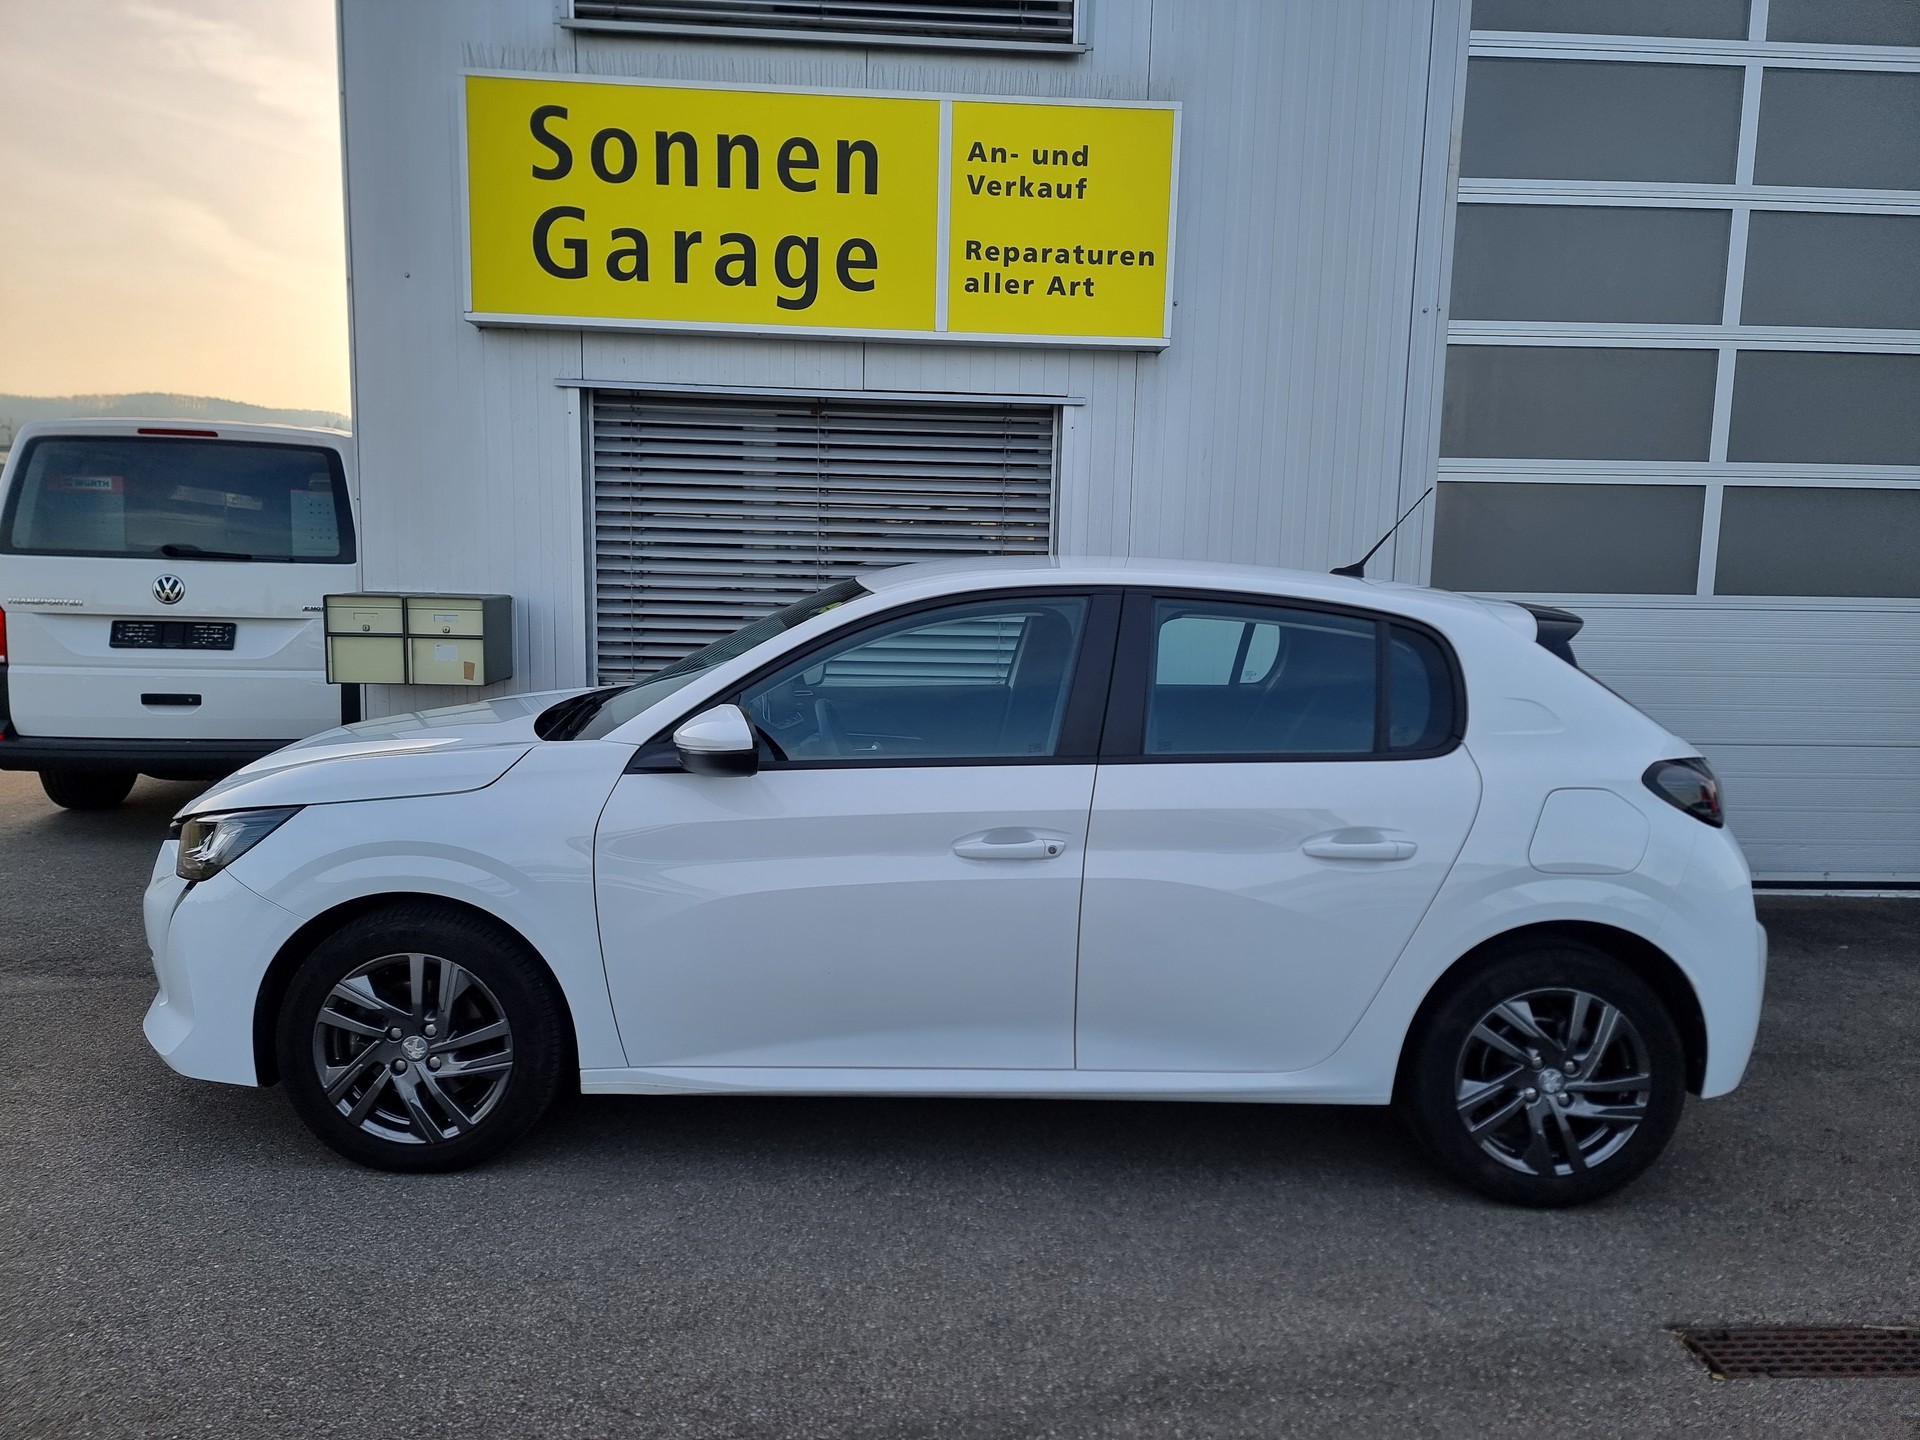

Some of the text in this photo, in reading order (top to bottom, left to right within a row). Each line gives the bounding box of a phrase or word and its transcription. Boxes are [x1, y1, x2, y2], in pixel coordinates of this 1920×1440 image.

[530, 105, 880, 196] Sonnen
[966, 141, 1089, 167] An- und
[966, 175, 1088, 200] Verkauf
[533, 206, 879, 311] Garage
[965, 240, 1155, 268] Reparaturen
[964, 272, 1095, 298] aller Art
